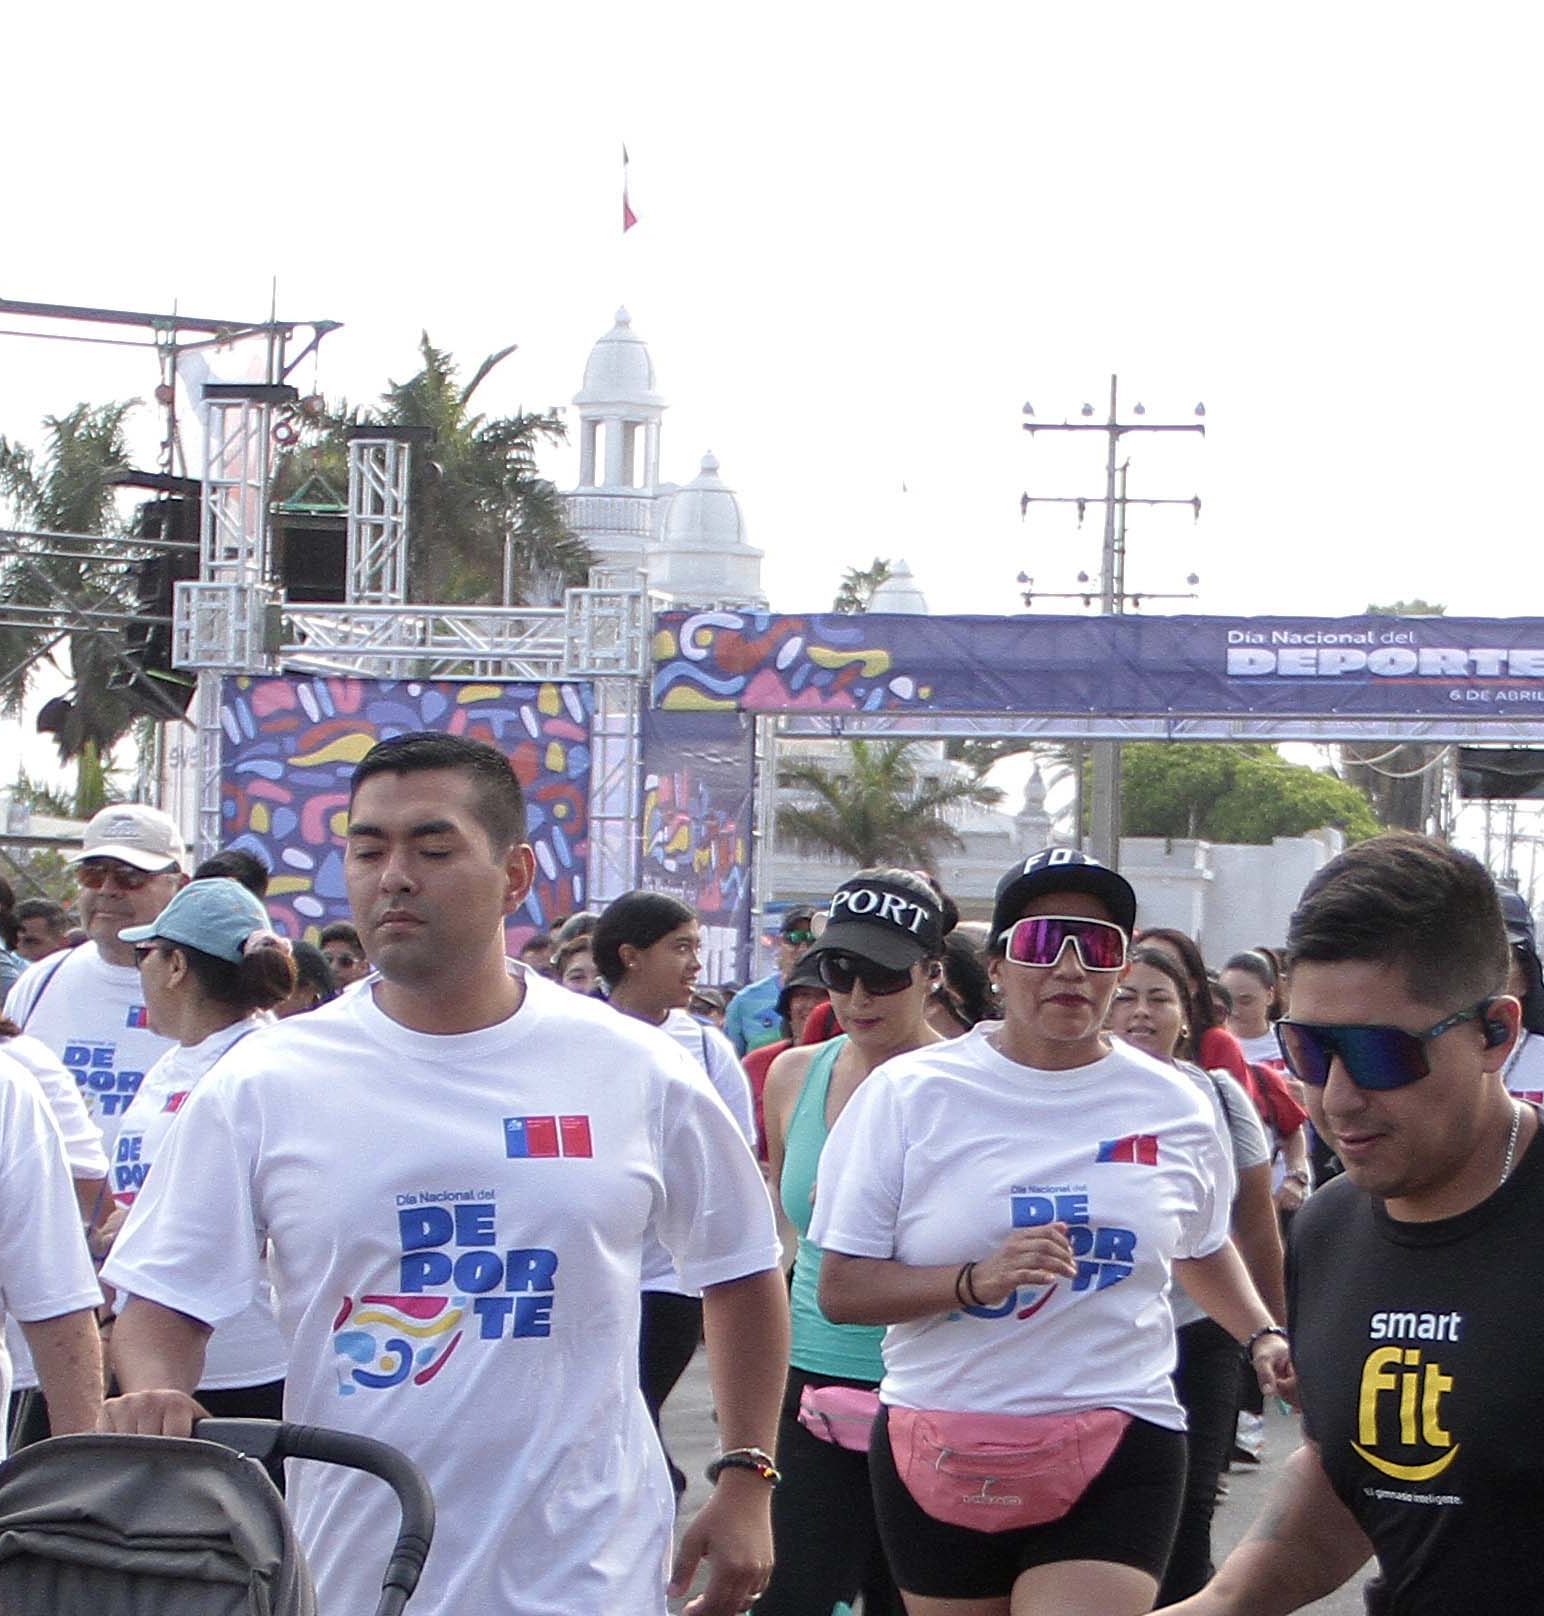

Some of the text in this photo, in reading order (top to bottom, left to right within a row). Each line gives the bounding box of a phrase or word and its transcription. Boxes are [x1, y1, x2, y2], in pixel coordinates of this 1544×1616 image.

[1227, 631, 1416, 645] Día Nacional del
[1448, 689, 1462, 701] 6
[1465, 690, 1490, 701] DE
[63, 1046, 115, 1068] DE
[118, 1136, 143, 1162] DE
[396, 1189, 495, 1206] Día Nacional del
[1011, 1194, 1090, 1228] DE
[398, 1203, 497, 1251] DE
[400, 1248, 559, 1294] POR
[473, 1295, 554, 1340] TE
[1369, 1311, 1461, 1342] smart
[1358, 1345, 1454, 1447] fit
